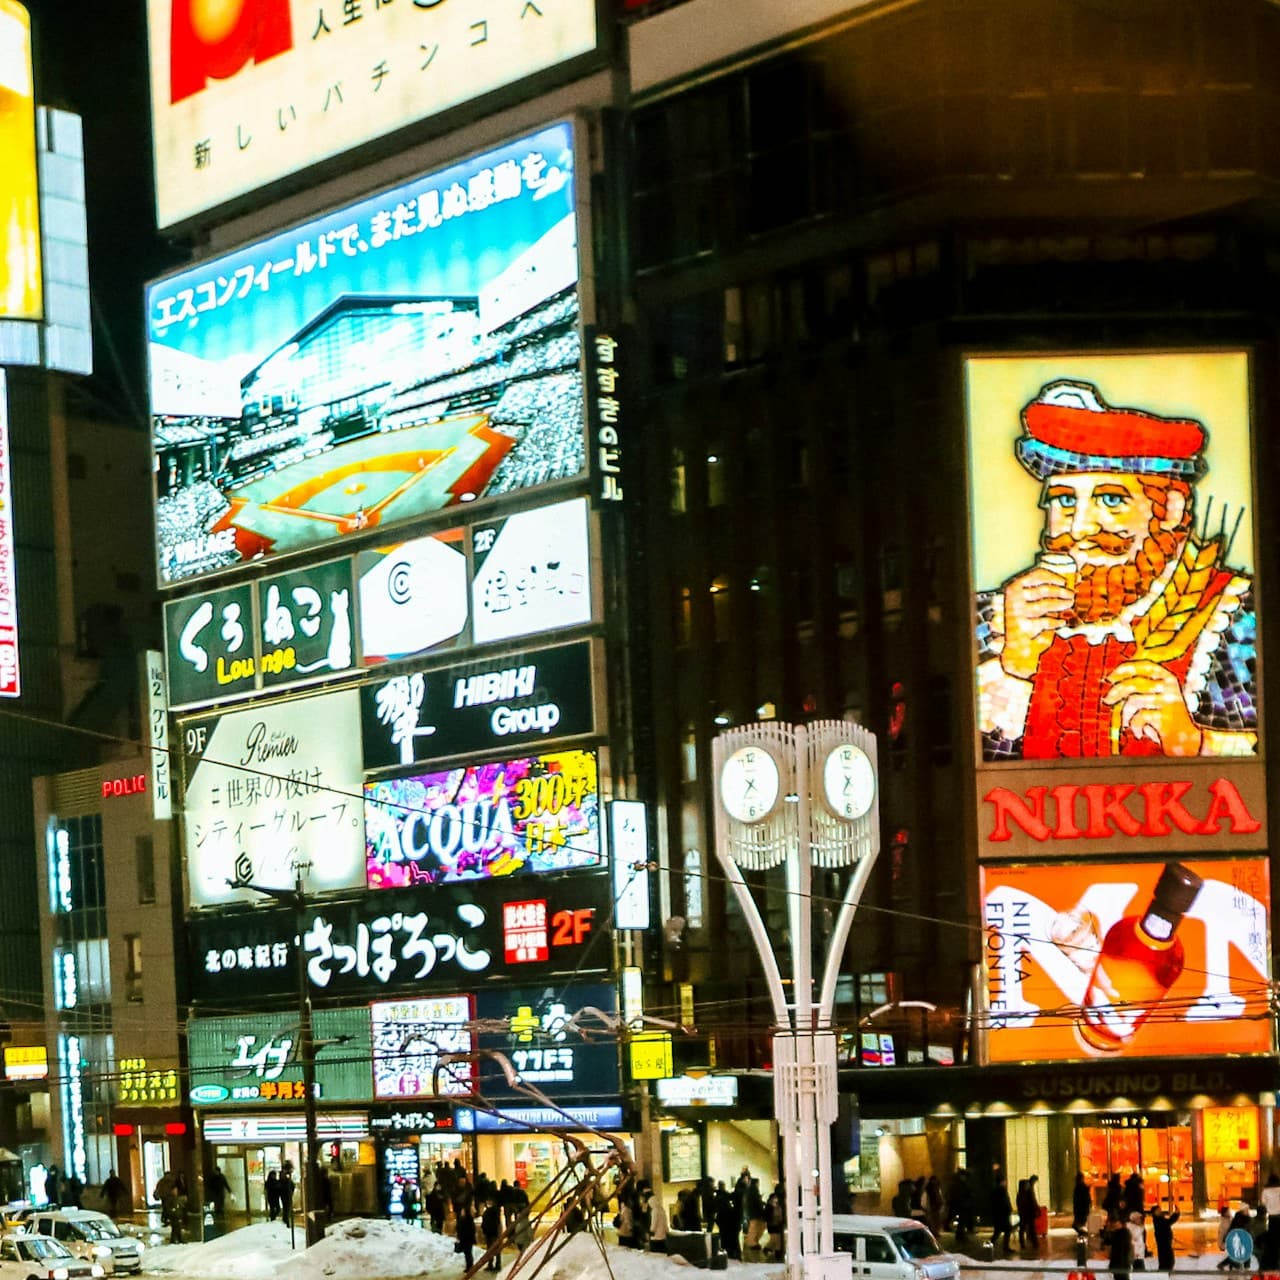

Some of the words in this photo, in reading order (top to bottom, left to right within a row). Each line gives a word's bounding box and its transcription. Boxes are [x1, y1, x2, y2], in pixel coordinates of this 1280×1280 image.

[175, 528, 236, 564] VILLAGE
[474, 528, 496, 552] 2F
[179, 585, 322, 672] くろねこ
[216, 648, 296, 684] Lounge
[454, 666, 535, 708] HIBIKI
[491, 704, 560, 735] Group
[187, 727, 207, 754] 9F
[102, 775, 146, 797] POLIC
[984, 778, 1261, 842] NIKKA
[377, 797, 515, 866] ACQUA
[552, 909, 592, 945] 2F
[1012, 901, 1031, 984] NIKKA
[205, 944, 287, 972] 北の味紀行
[303, 903, 490, 988] さっぽろっこ
[986, 902, 1007, 1031] FRONTIER
[1023, 1074, 1160, 1097] SUSUKINO
